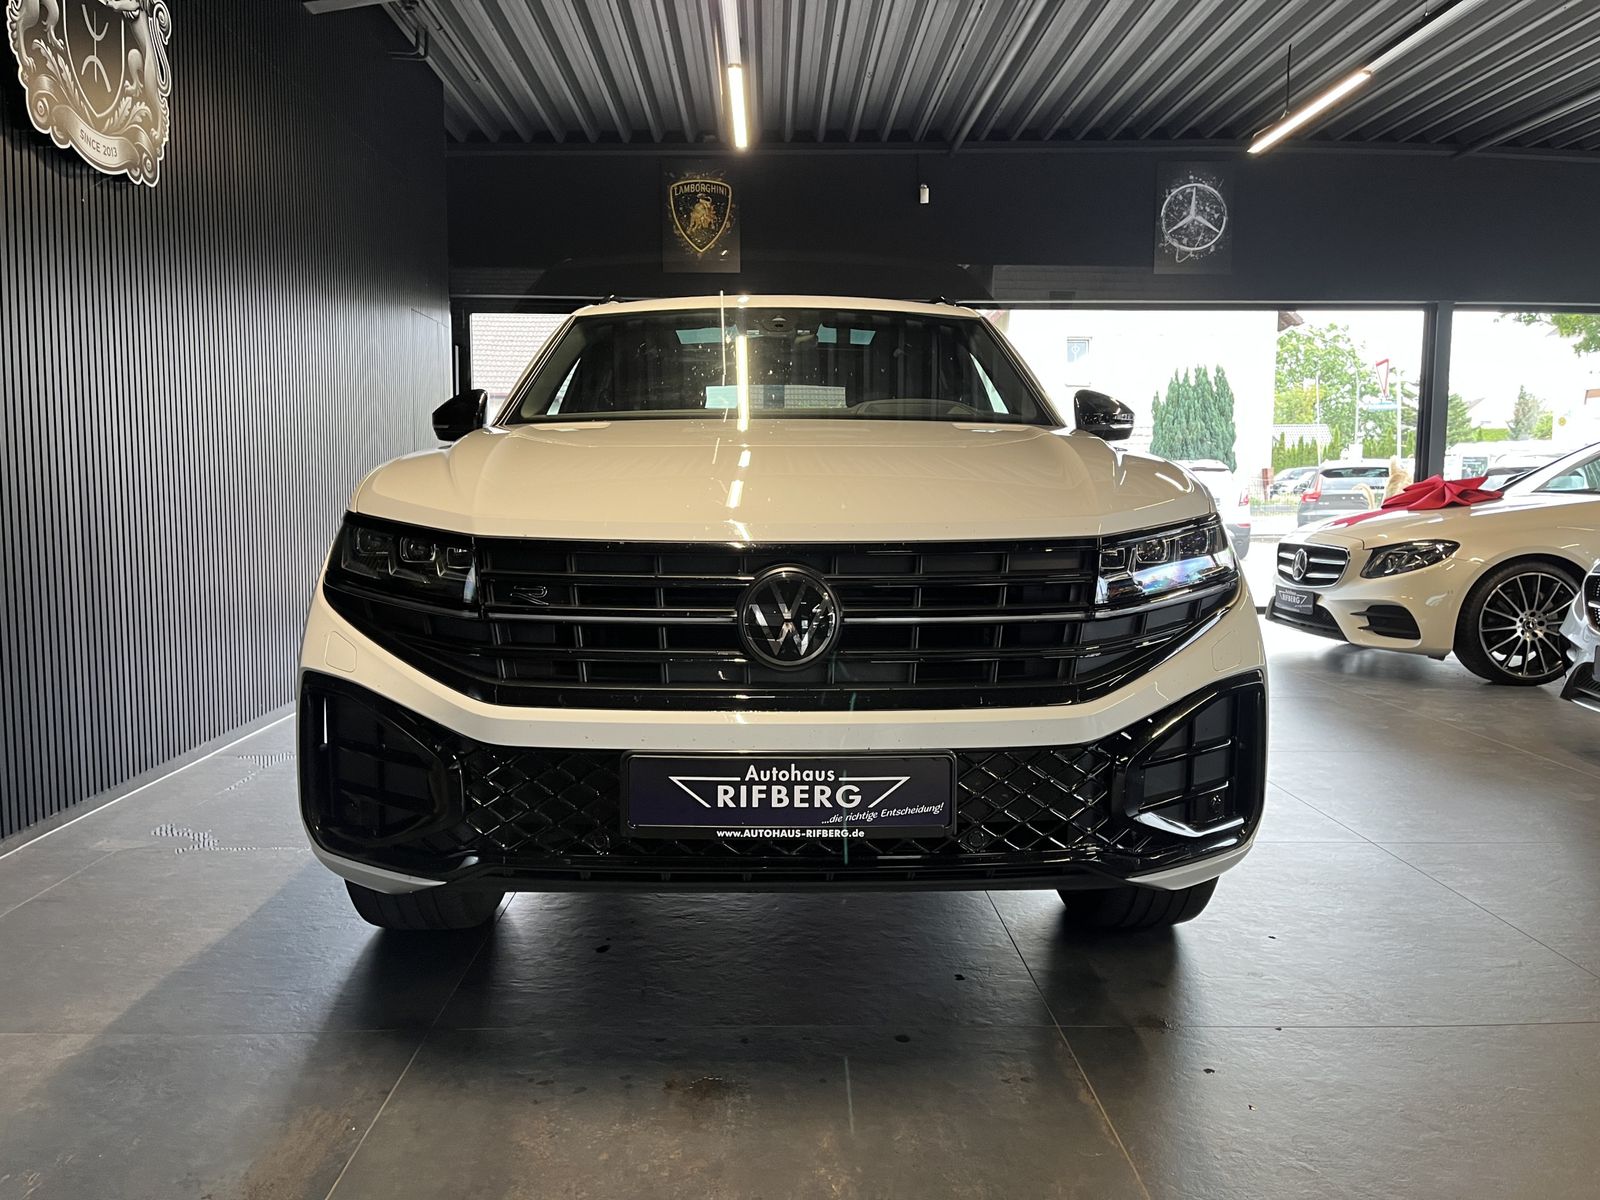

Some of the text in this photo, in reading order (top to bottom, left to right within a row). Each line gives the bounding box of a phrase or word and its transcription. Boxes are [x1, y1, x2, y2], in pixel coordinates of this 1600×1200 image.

[80, 129, 118, 158] SINCE 2013
[674, 183, 727, 196] LAMBORGHINI
[744, 763, 835, 782] Autohaus
[717, 784, 862, 808] RIFBERG
[845, 810, 879, 822] richtige
[880, 802, 945, 817] Entscheidung!
[716, 829, 865, 838] www.AUTOHAUS-RIFBERG.de
